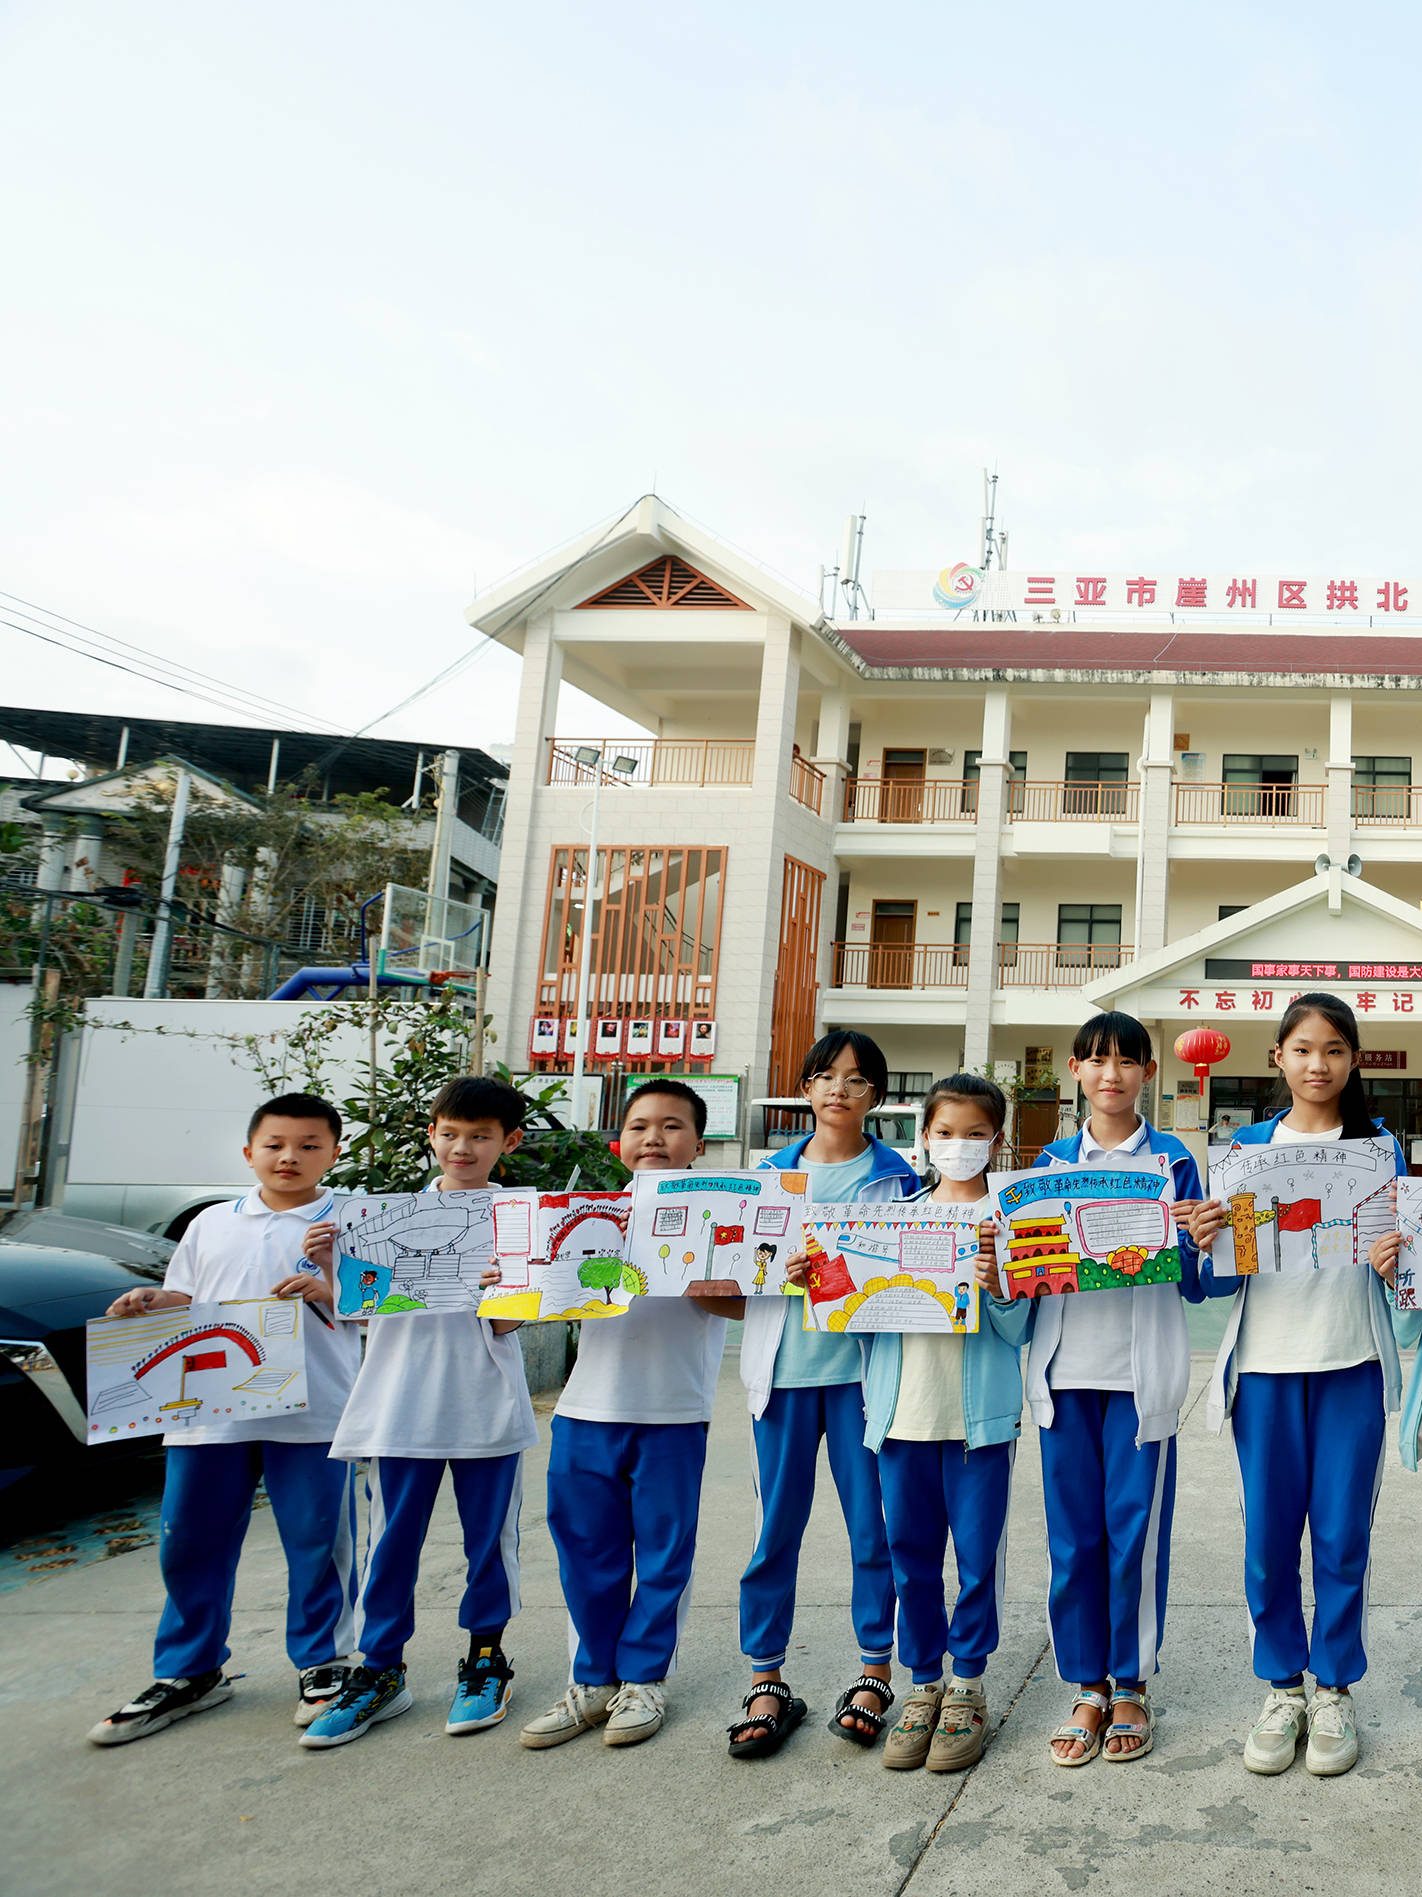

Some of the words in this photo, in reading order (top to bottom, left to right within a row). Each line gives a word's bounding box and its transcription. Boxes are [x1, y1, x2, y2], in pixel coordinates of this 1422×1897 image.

[1241, 1149, 1347, 1175] 传承红色精神
